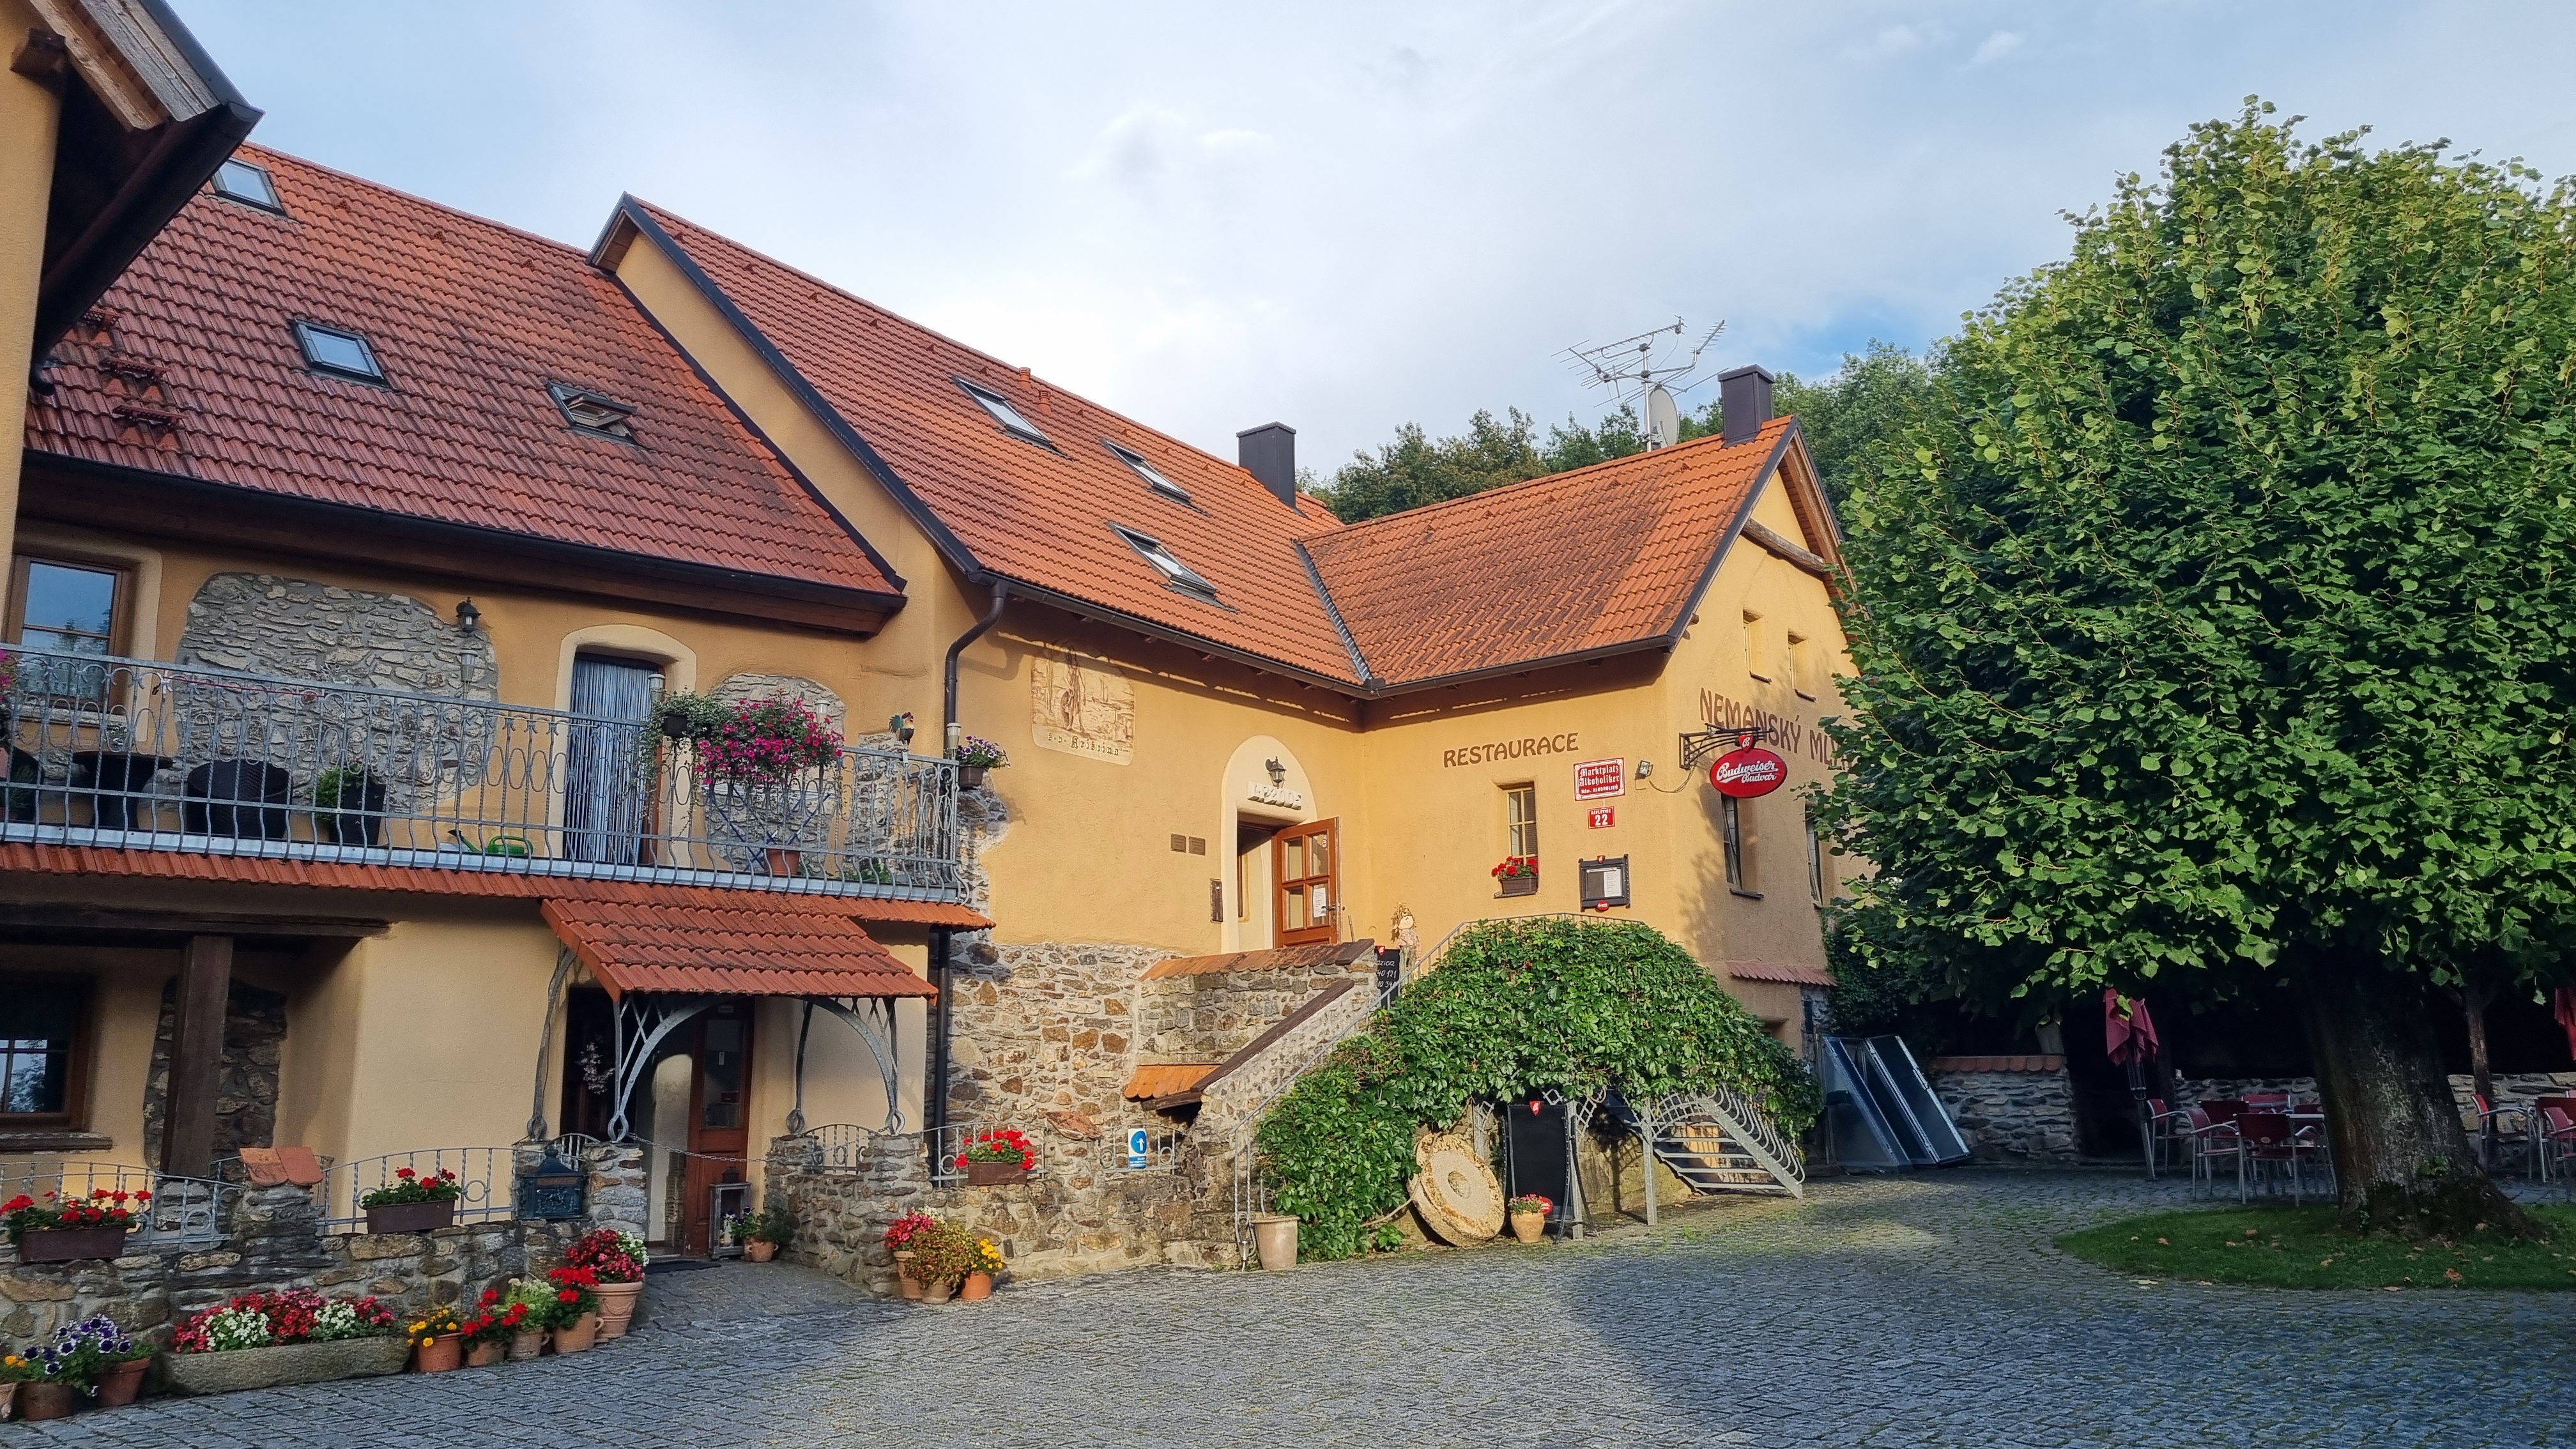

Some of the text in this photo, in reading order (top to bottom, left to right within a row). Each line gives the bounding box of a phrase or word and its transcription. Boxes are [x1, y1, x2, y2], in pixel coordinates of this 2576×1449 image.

[1443, 732, 1579, 768] RESTAURACE
[1809, 729, 1852, 771] ML
[1580, 765, 1619, 778] Marktplatz
[1716, 760, 1779, 782] Budweiser
[1741, 772, 1777, 783] Budvar
[1579, 774, 1620, 787] Alkoholiker
[1595, 814, 1608, 826] 22
